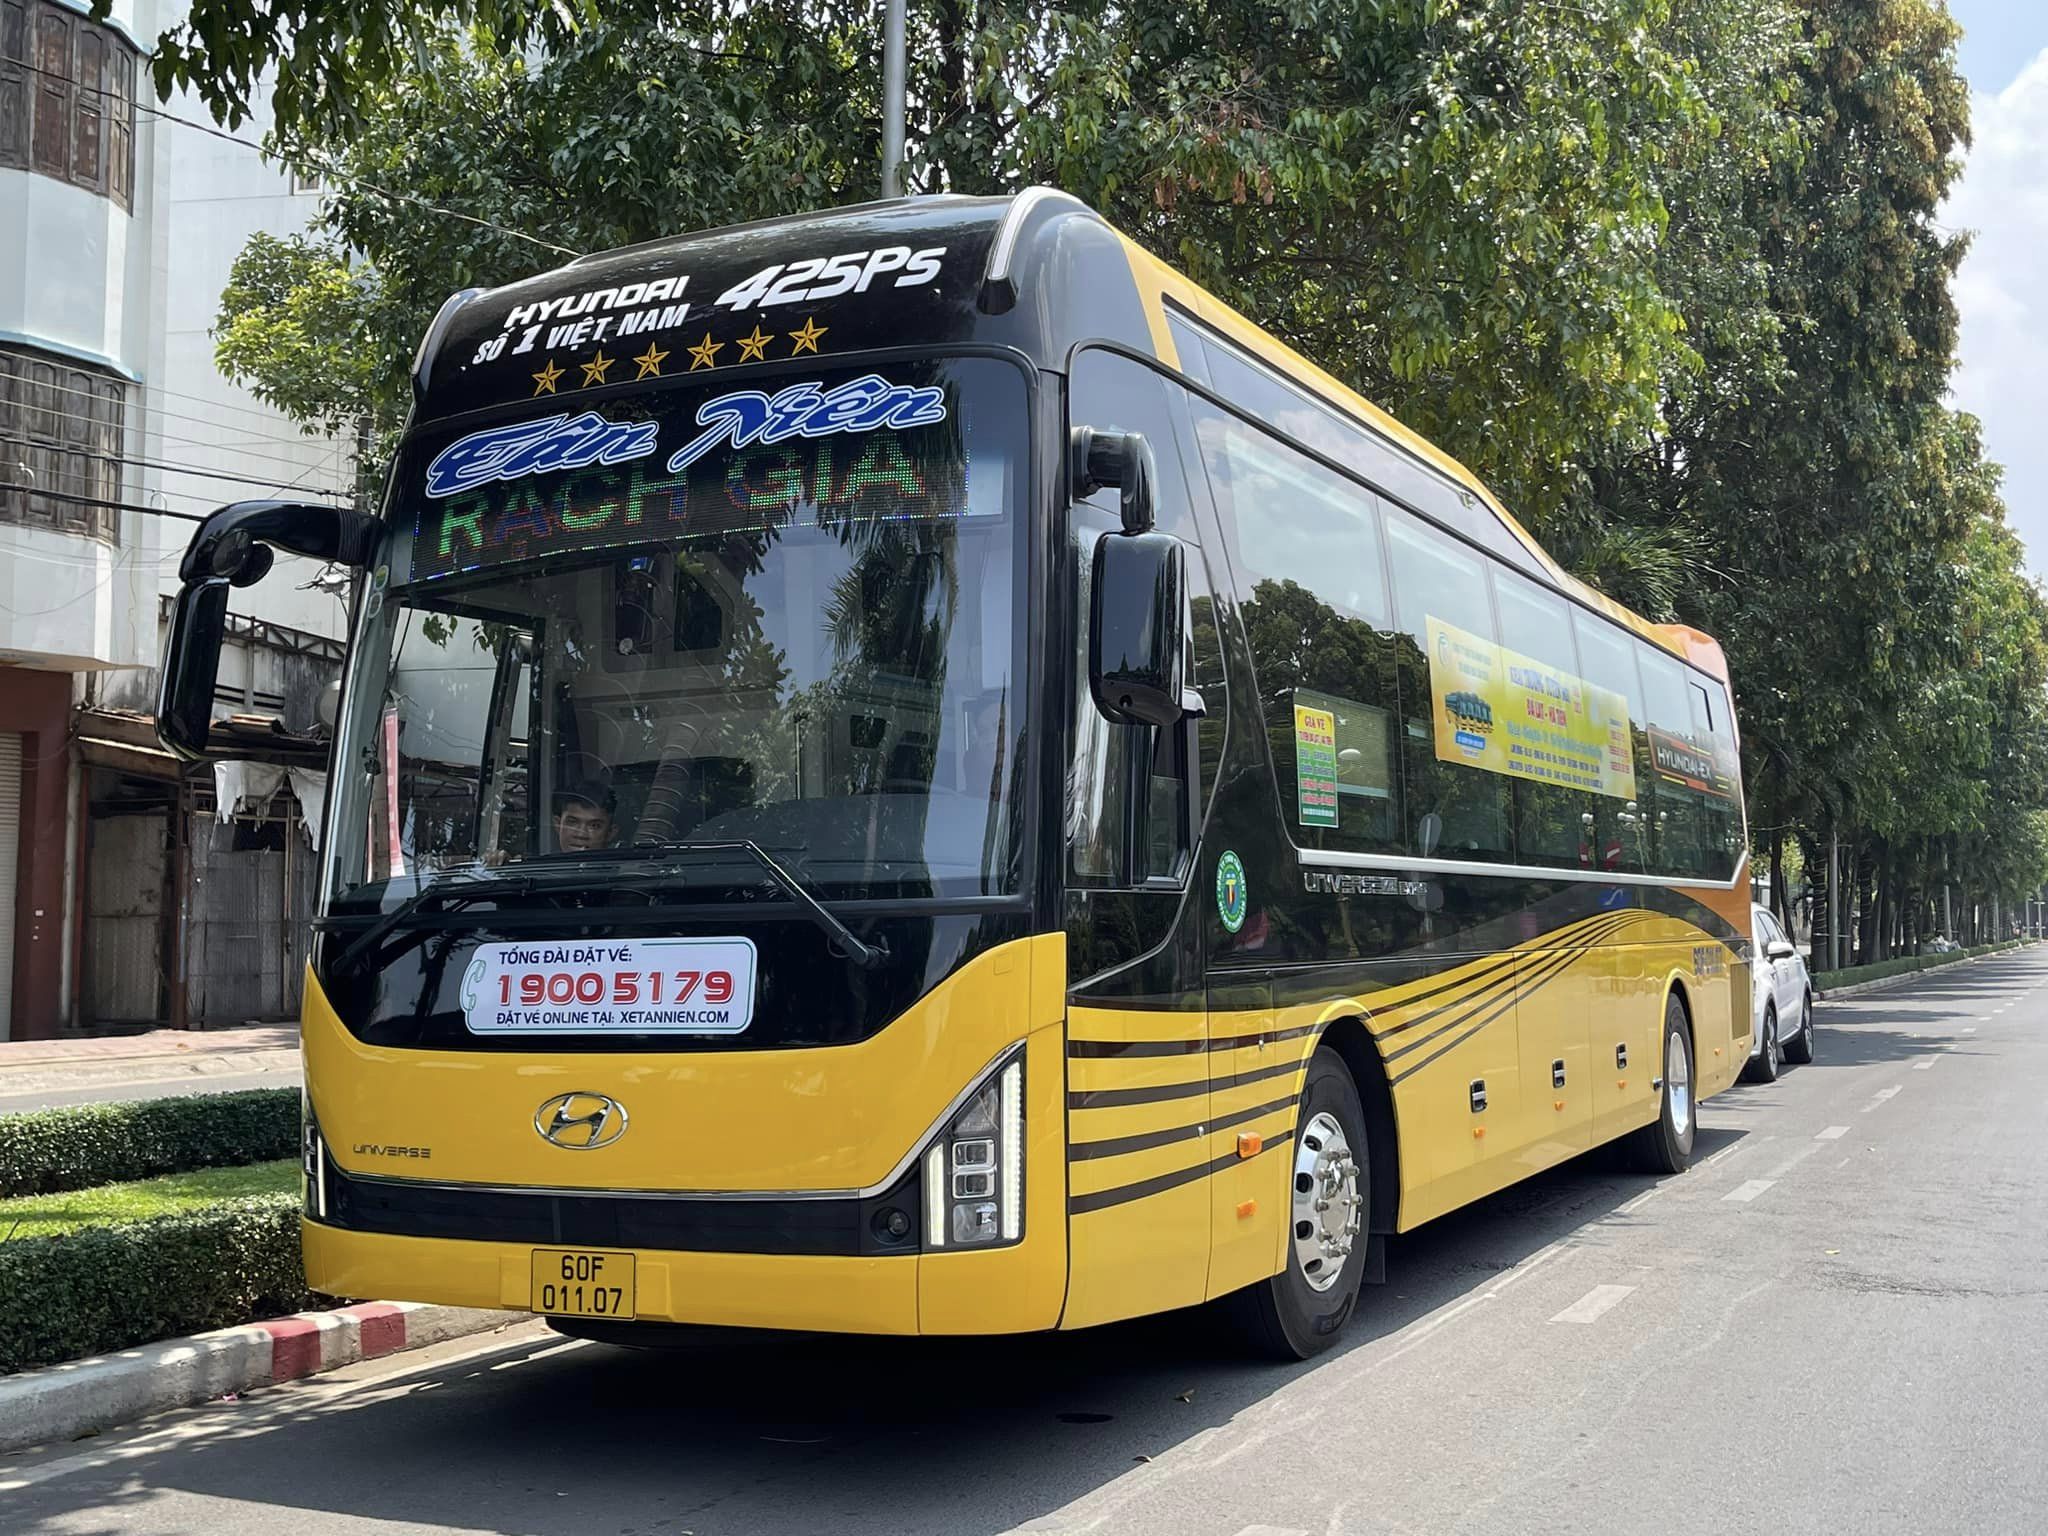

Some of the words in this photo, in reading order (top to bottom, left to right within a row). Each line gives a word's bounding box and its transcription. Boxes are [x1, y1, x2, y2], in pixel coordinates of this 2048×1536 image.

[504, 275, 690, 328] HYUNDAI
[472, 327, 515, 365] SỐ
[512, 324, 543, 355] 1
[545, 316, 613, 351] VIỆT
[616, 303, 691, 337] NAM
[543, 947, 569, 963] ĐÀI
[573, 946, 605, 966] ĐẶT
[496, 1010, 521, 1027] ĐẶT
[524, 1009, 540, 1024] VÉ
[543, 1011, 589, 1024] ONLINE
[620, 1011, 729, 1023] XETANNIEN.COM
[353, 1144, 431, 1158] UNIVERSE
[561, 1255, 604, 1282] 60F
[543, 1284, 622, 1314] 011.07
